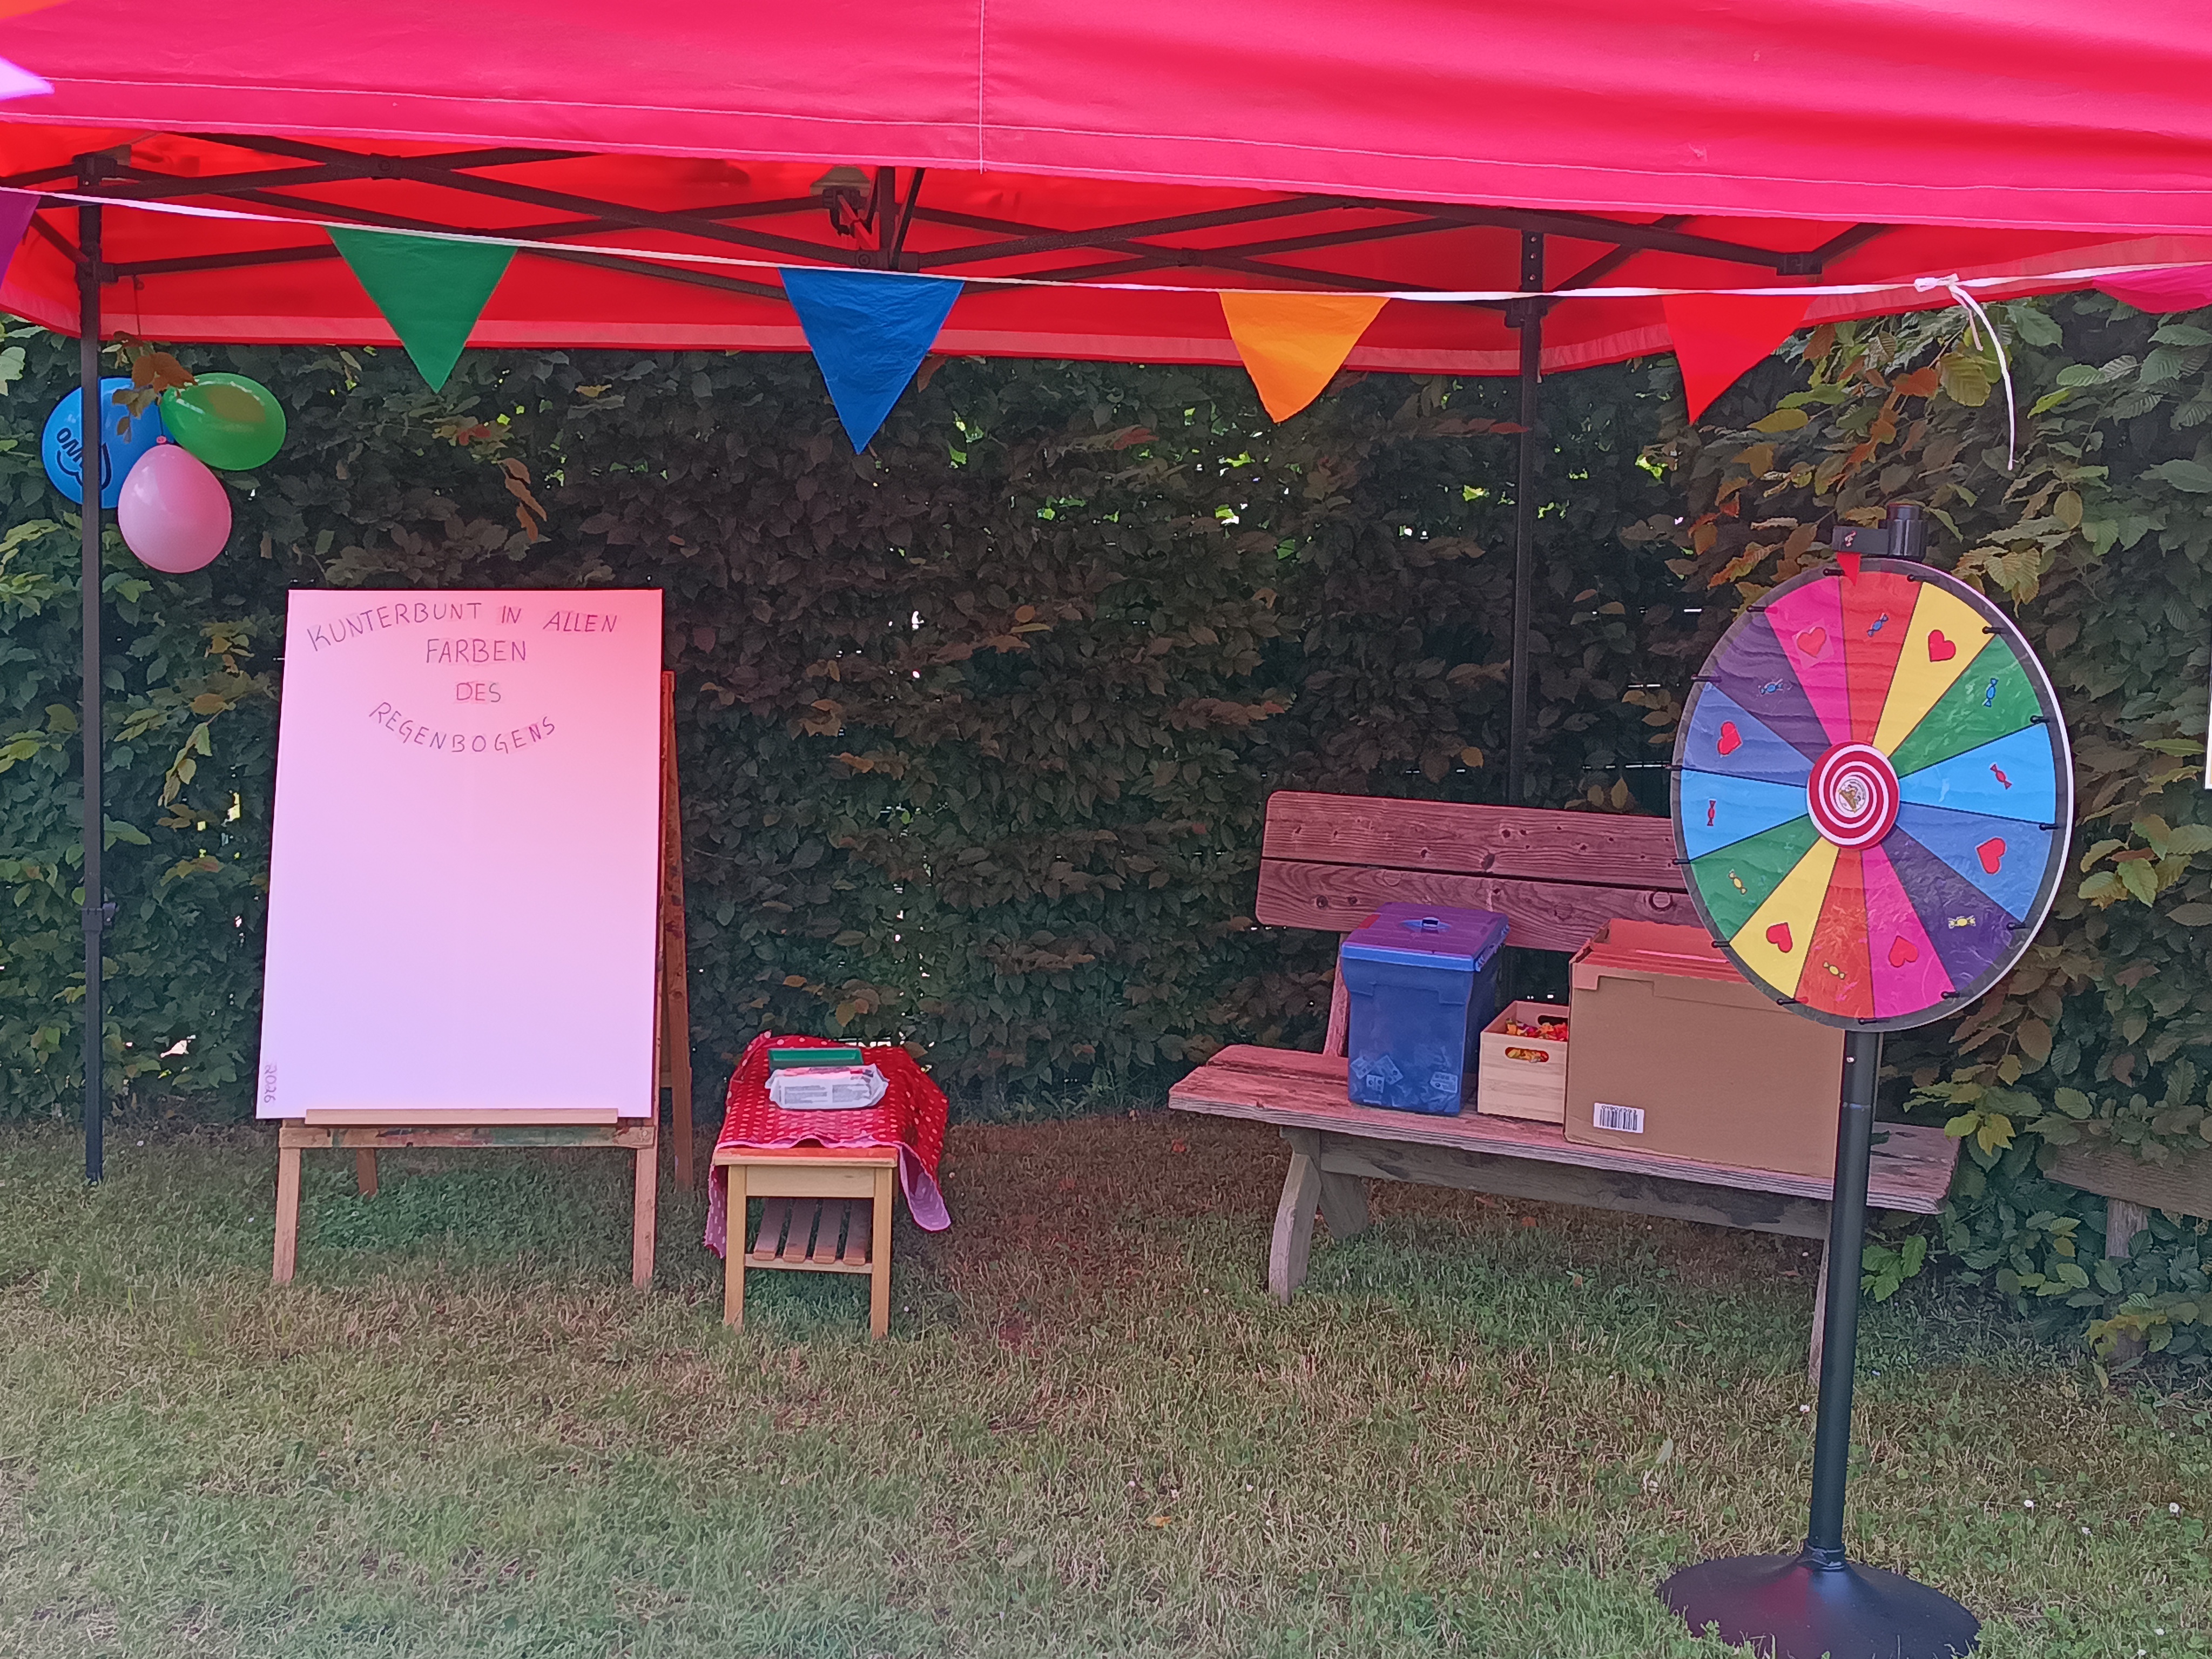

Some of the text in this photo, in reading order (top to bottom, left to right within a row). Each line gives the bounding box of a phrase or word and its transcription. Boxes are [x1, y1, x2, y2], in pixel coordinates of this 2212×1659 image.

[307, 602, 618, 651] KUNTERBUNT IN ALLEN
[426, 638, 527, 663] FARBEN
[455, 682, 502, 703] DES
[368, 702, 556, 754] REGENBOGENS
[264, 1064, 278, 1103] 2026
